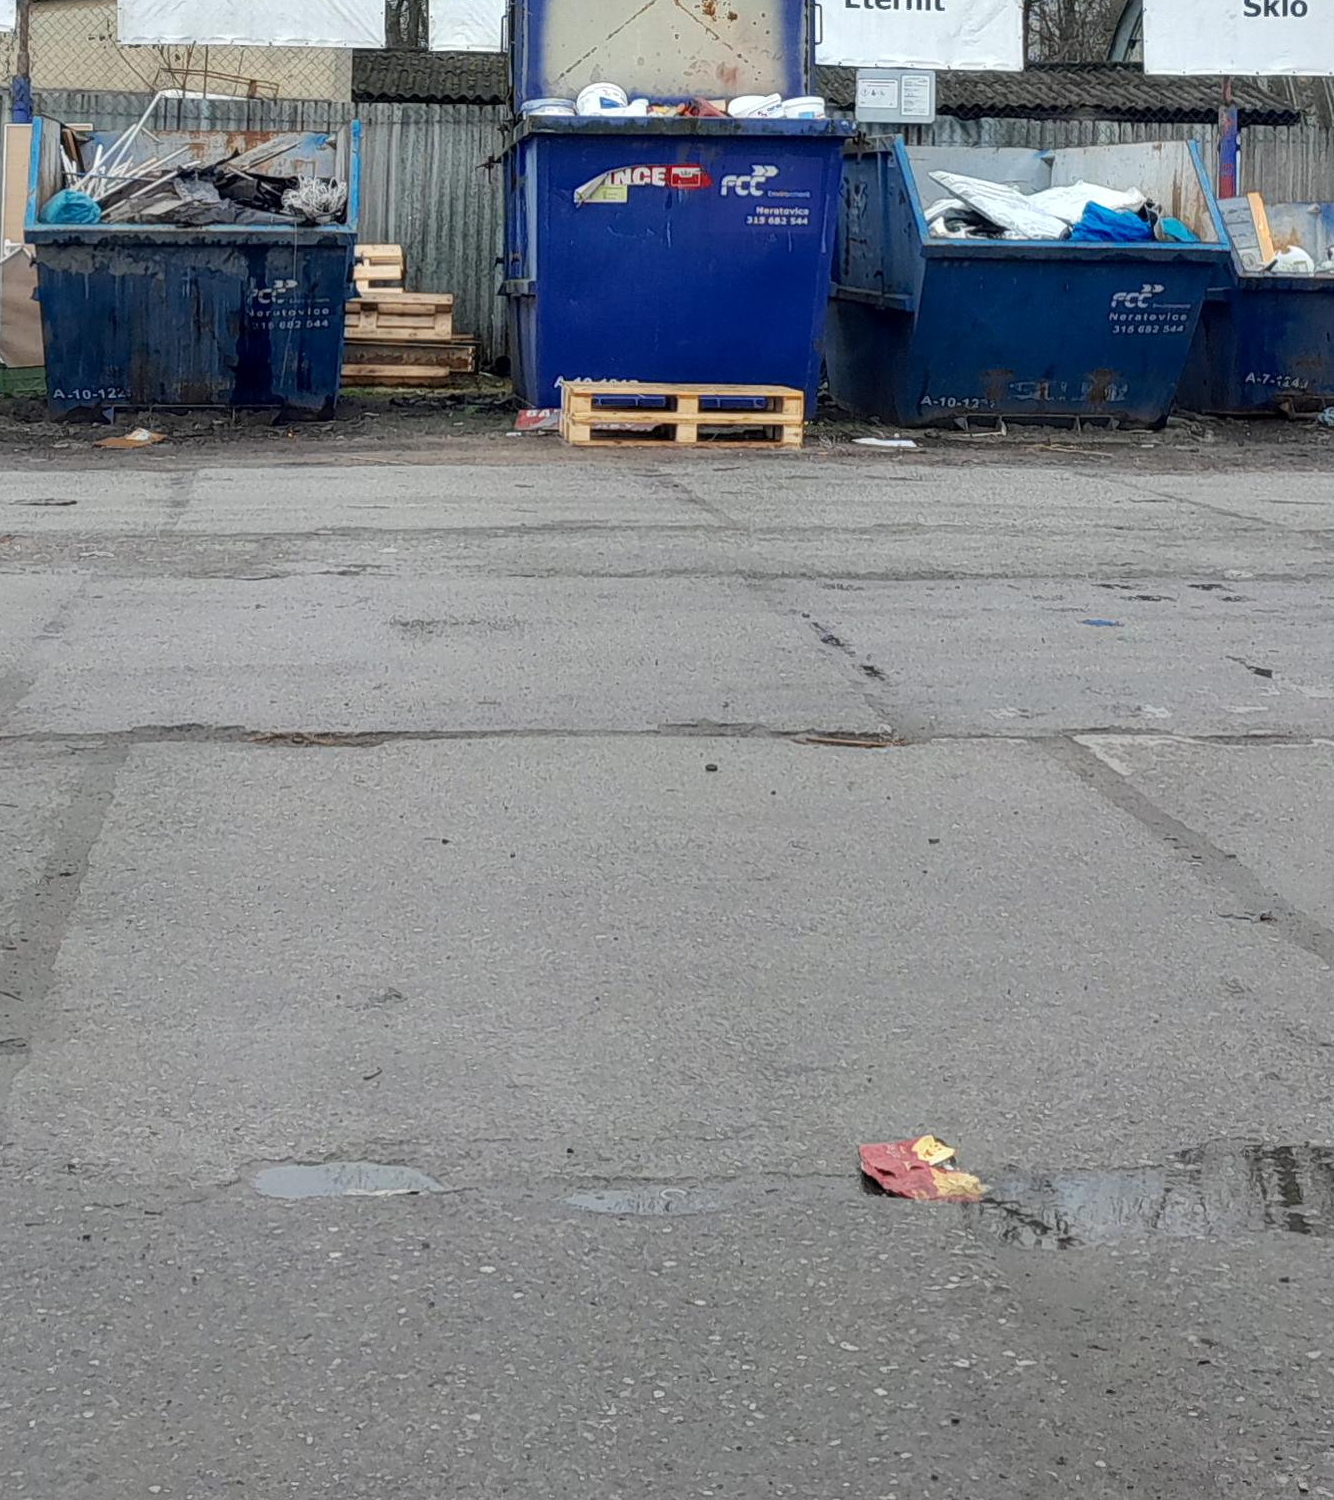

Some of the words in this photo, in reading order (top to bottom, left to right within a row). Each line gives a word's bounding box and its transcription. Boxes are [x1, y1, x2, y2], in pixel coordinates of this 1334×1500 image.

[721, 175, 766, 197] FCC
[1111, 292, 1152, 309] FCC
[1109, 312, 1189, 322] Neratovice
[1137, 325, 1160, 334] 682
[1163, 325, 1185, 333] 544
